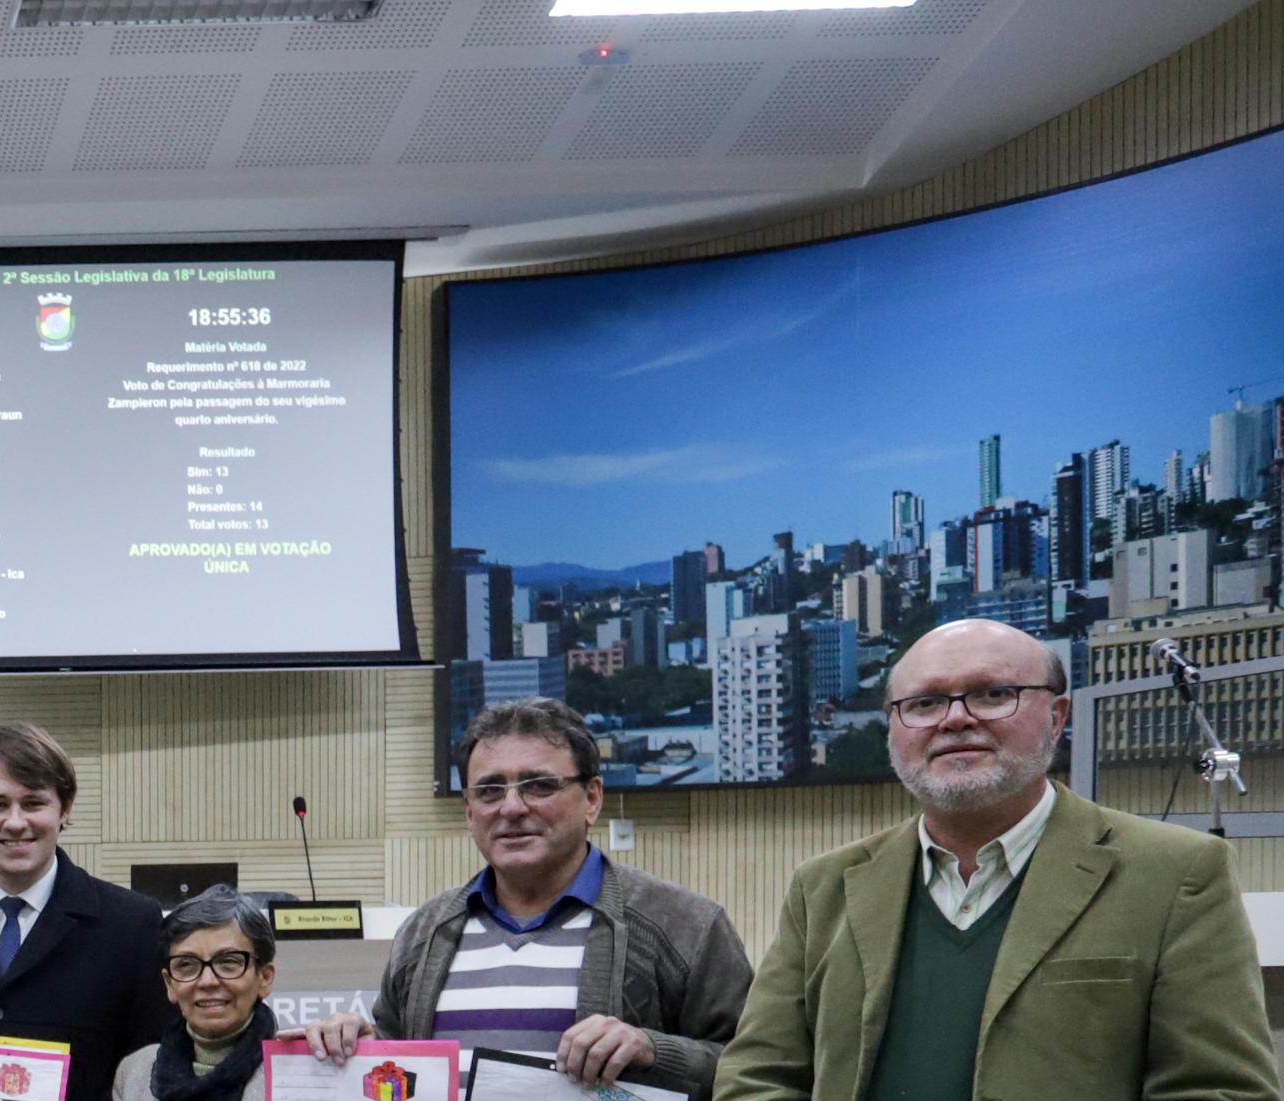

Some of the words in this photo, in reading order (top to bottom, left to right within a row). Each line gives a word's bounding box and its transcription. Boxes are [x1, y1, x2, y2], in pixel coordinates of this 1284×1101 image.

[3, 271, 16, 285] 2ª
[20, 271, 70, 284] Sessão
[74, 271, 149, 285] Legislativa
[152, 270, 169, 282] da
[173, 269, 195, 281] 18ª
[199, 268, 275, 282] Legislatura
[188, 309, 271, 326] 18:55:36
[185, 342, 225, 352] Matéria
[228, 342, 266, 352] Votada
[147, 362, 224, 374] Requerimento
[241, 361, 261, 372] 618
[263, 361, 277, 371] de
[280, 361, 306, 371] 2022
[123, 380, 148, 391] Voto
[150, 380, 164, 390] de
[167, 378, 254, 392] Congratulações
[257, 379, 264, 389] à
[267, 379, 330, 389] Marmoraria
[108, 397, 167, 410] Zampieron
[170, 397, 193, 409] pela
[196, 397, 252, 409] passagem
[255, 396, 269, 407] do
[272, 397, 292, 406] seu
[296, 395, 345, 407] vigésimo
[175, 415, 212, 427] quarto
[214, 413, 278, 425] aniversário.
[199, 447, 255, 458] Resultado
[187, 467, 212, 477] Sim:
[216, 467, 228, 477] 13
[187, 484, 213, 495] Não:
[216, 484, 223, 494] 0
[188, 502, 247, 512] Presentes:
[250, 502, 263, 511] 14
[188, 519, 215, 530] Total
[217, 520, 252, 529] votos:
[255, 519, 268, 529] 13
[130, 543, 231, 557] APROVADO(A)
[235, 543, 257, 555] EM
[261, 540, 331, 557] VOTAÇÃO
[204, 558, 250, 573] ÚNICA
[8, 570, 24, 579] Ica
[263, 990, 375, 1024] RETÁ
